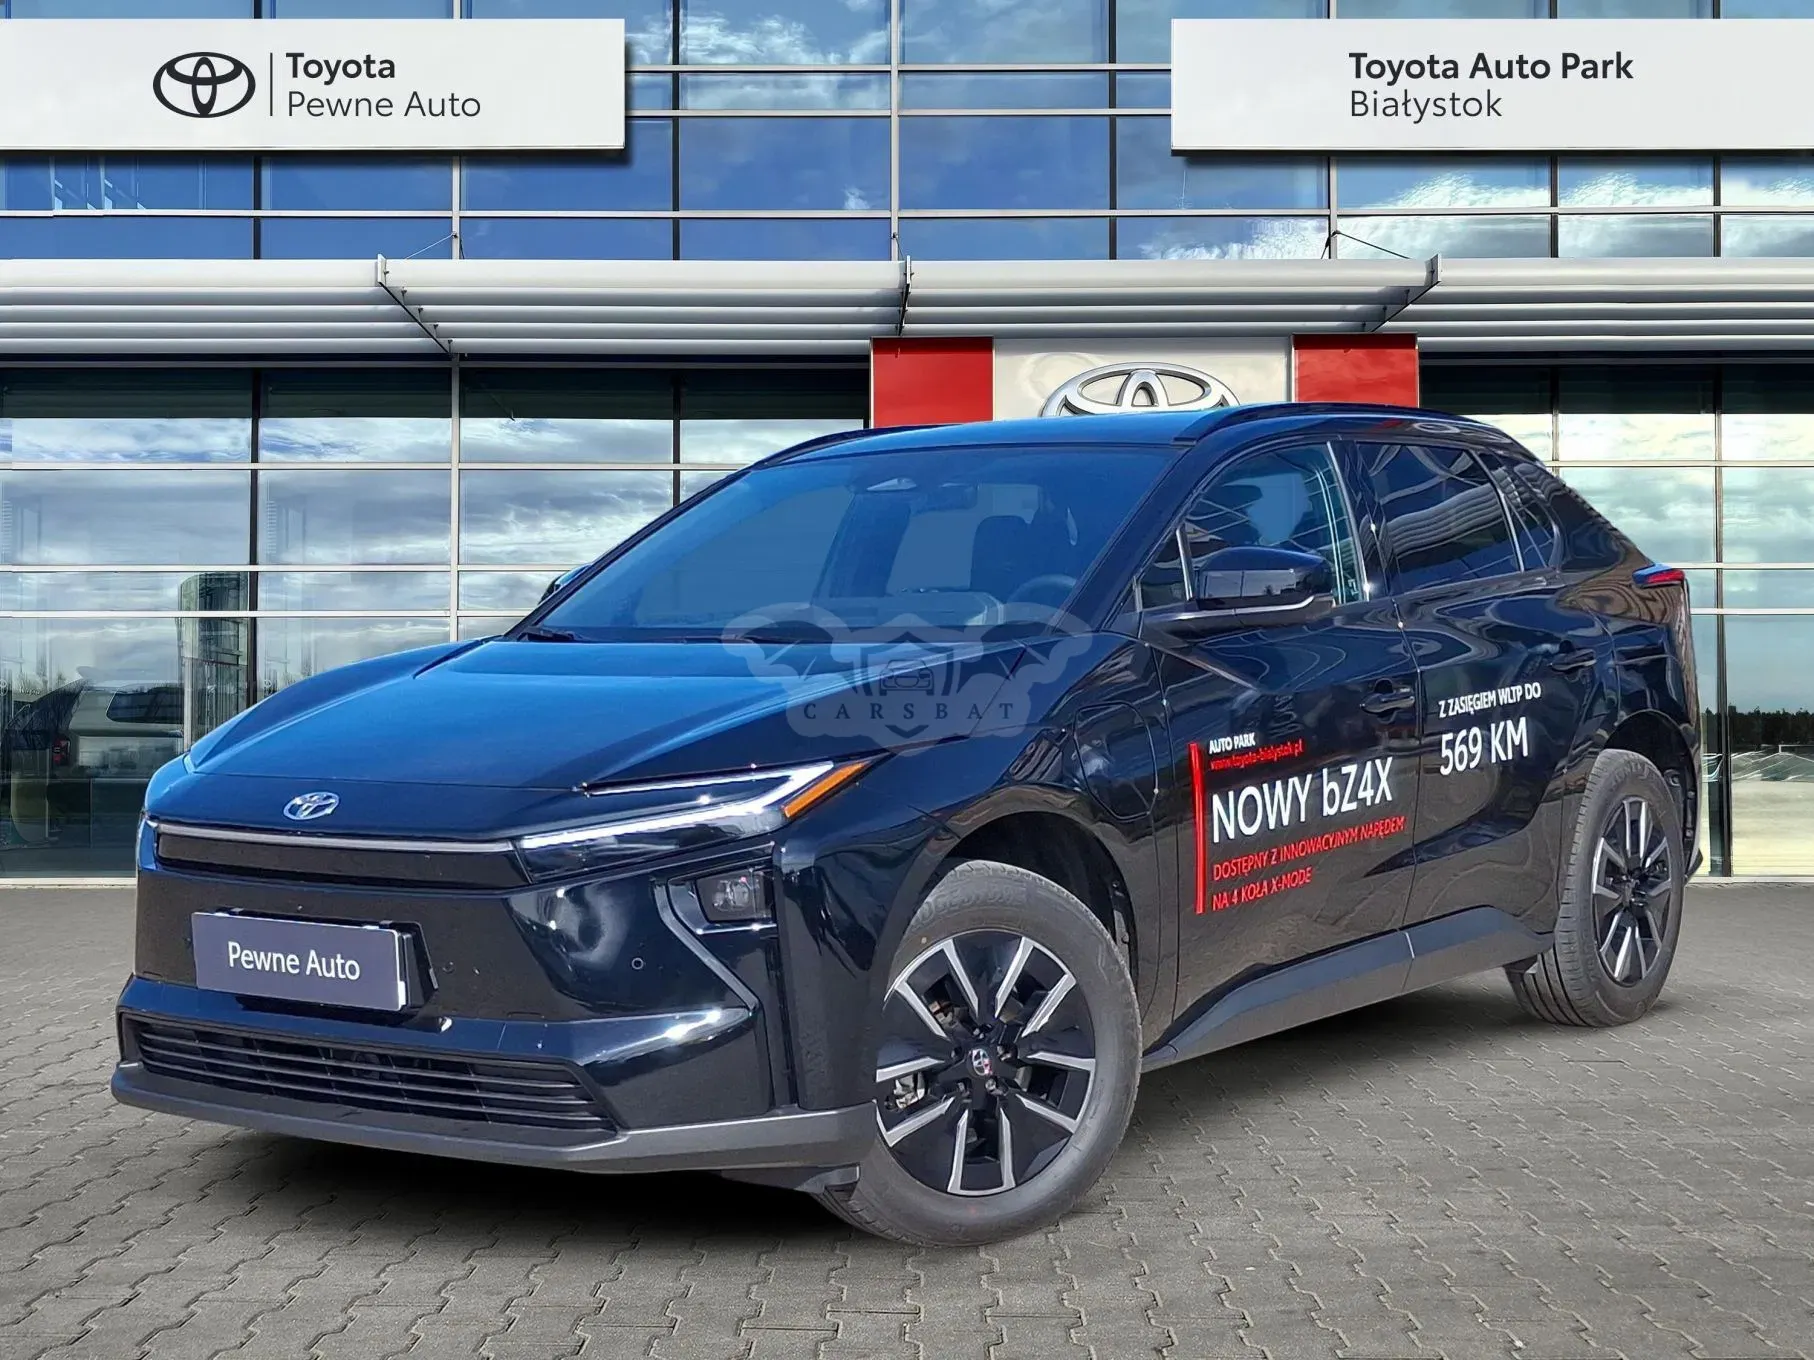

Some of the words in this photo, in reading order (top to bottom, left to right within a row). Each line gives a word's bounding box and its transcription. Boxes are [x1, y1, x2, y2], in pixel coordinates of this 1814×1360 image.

[285, 52, 396, 85] Toyota
[1349, 52, 1459, 86] Toyota
[1469, 52, 1551, 79] Auto
[1561, 51, 1634, 79] Park
[288, 90, 393, 117] Pewne
[404, 91, 481, 117] Auto
[1350, 89, 1502, 124] Białystok
[1438, 700, 1447, 718] Z
[1448, 690, 1496, 715] ZASIĘGIEM
[1498, 685, 1522, 706] WLTP
[1524, 682, 1541, 700] DO
[1209, 739, 1233, 754] AUTO
[1233, 732, 1256, 749] PARK
[1440, 726, 1483, 775] 569
[1490, 716, 1528, 763] KM
[1212, 773, 1312, 843] NOWY
[1322, 757, 1393, 817] bZ4X
[1214, 854, 1268, 881] DOSTĘPNY
[1271, 848, 1278, 865] Z
[1280, 828, 1358, 862] INNOWACYJNYM
[1360, 816, 1405, 841] NAPĘDEM
[1213, 892, 1228, 911] NA
[1231, 890, 1238, 905] 4
[1241, 880, 1268, 903] KOŁA
[1271, 867, 1312, 894] X-MODE
[227, 941, 300, 975] Pewne
[305, 949, 361, 981] Auto
